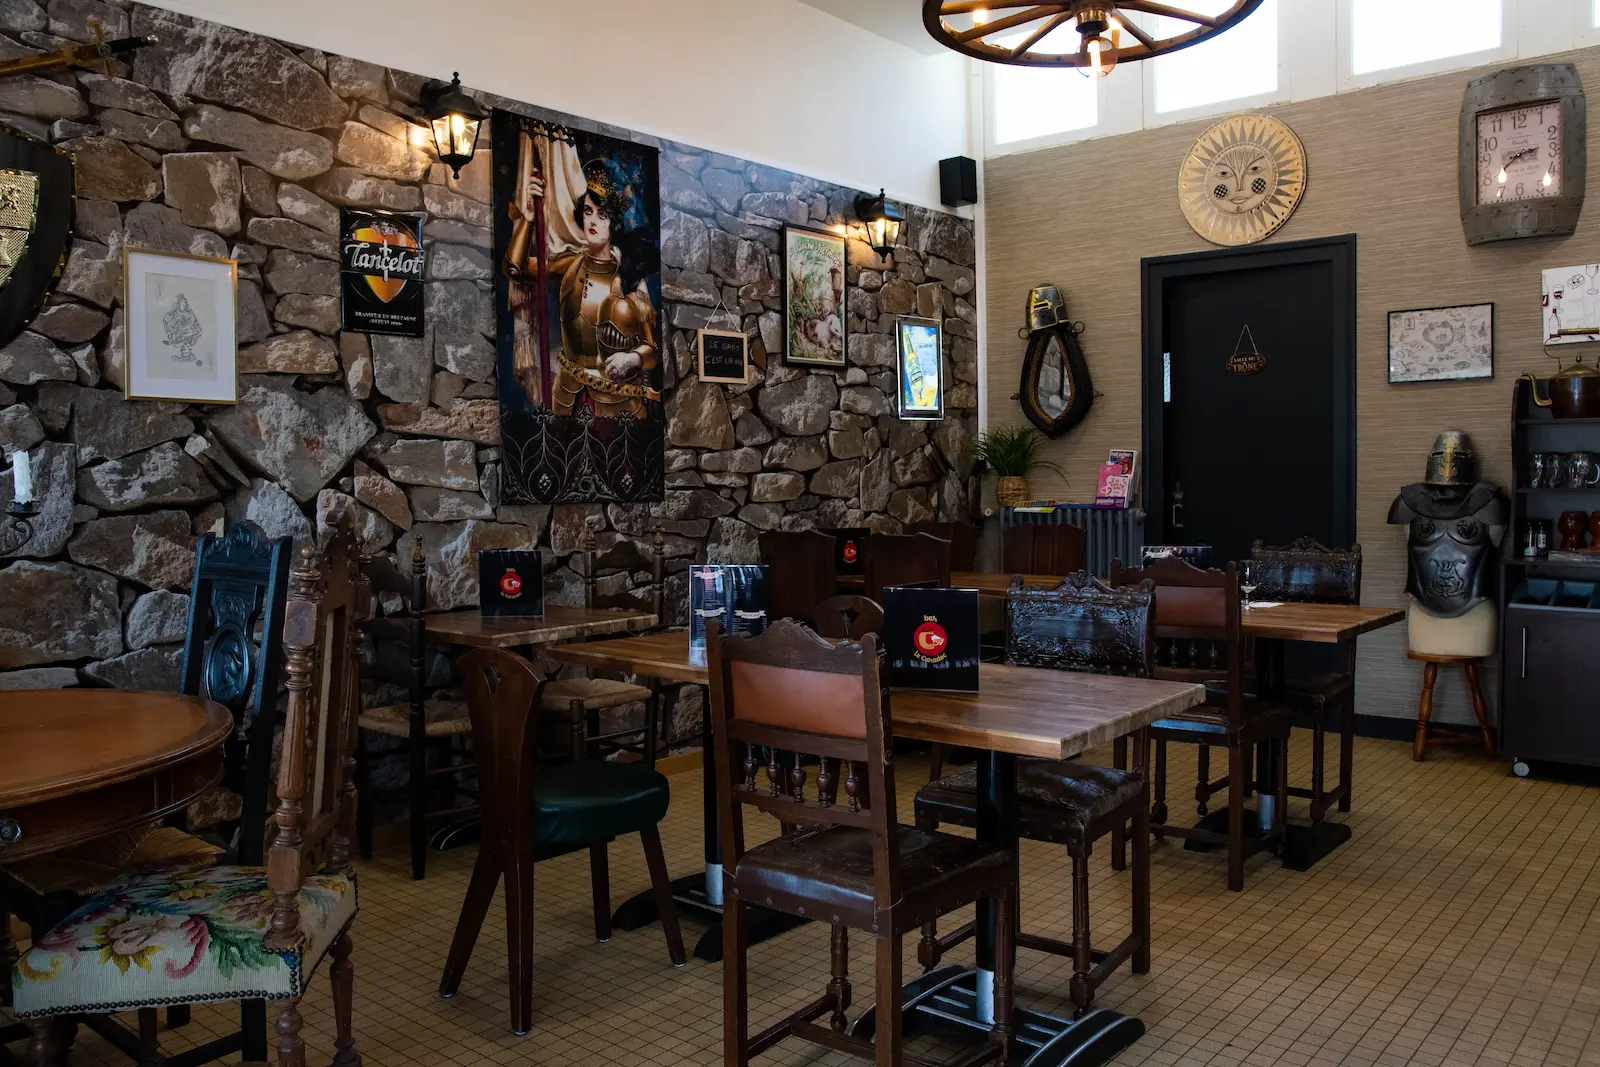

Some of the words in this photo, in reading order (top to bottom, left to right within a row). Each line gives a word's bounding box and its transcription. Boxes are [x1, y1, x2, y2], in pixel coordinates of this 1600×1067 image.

[1491, 119, 1502, 133] 11
[1511, 114, 1527, 129] 12
[1538, 110, 1543, 124] 1
[1483, 136, 1497, 151] 10
[1547, 125, 1556, 140] 2
[1483, 153, 1491, 168] 9
[1548, 141, 1556, 157] 3
[1483, 170, 1492, 186] 8
[1548, 161, 1556, 176] 4
[1497, 186, 1506, 198] 7
[1515, 182, 1524, 196] 6
[344, 242, 423, 275] Lancelot
[354, 311, 381, 319] BRASSEUR
[390, 314, 416, 322] BRETAGNE
[709, 340, 719, 349] LE
